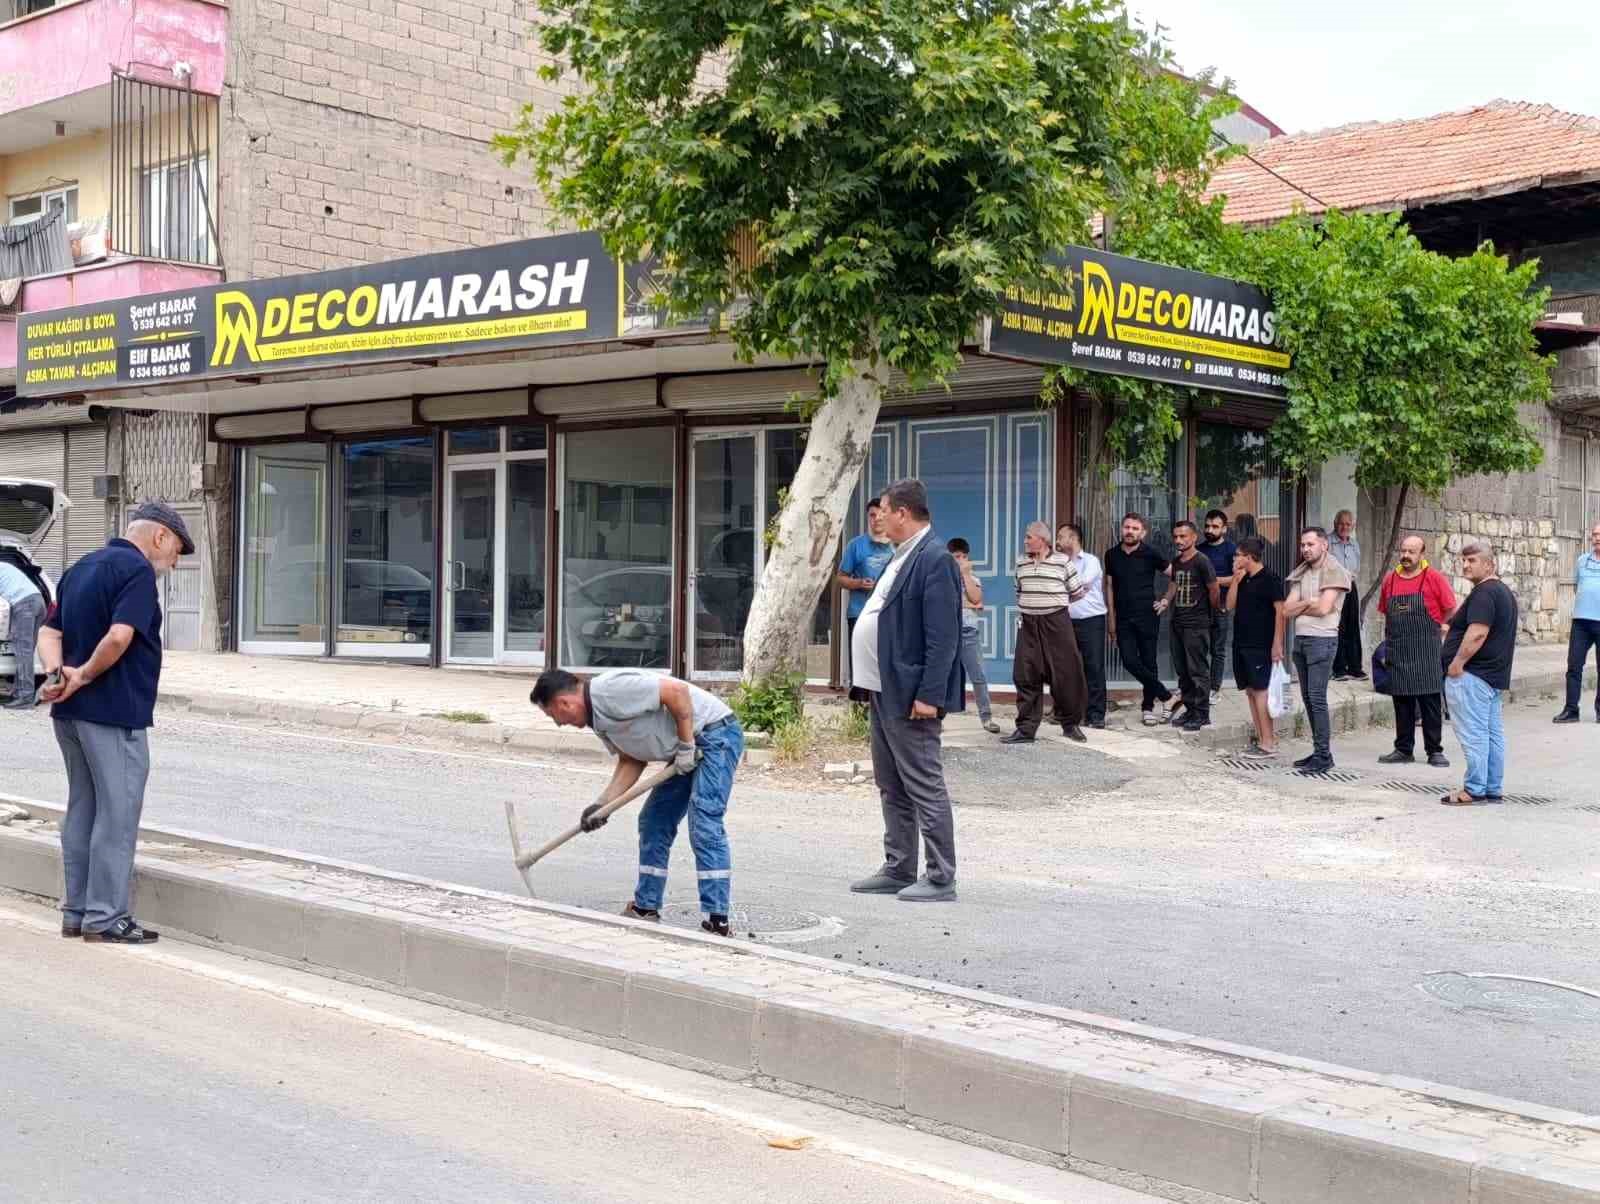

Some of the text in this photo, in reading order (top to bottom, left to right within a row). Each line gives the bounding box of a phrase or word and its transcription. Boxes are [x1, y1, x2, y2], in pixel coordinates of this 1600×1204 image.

[262, 258, 589, 337] DECOMARASH
[130, 296, 196, 322] Şeref BARAK
[172, 314, 183, 325] 41
[184, 312, 194, 324] 37
[1117, 282, 1281, 346] DECOMARAS
[27, 324, 55, 339] DUVAR
[93, 314, 115, 330] BOYA
[28, 347, 45, 361] HER
[45, 342, 72, 359] TÜRLÜ
[129, 343, 191, 365] Elif BARAK
[1072, 341, 1122, 360] Şeref BARAK
[25, 369, 47, 384] ASMA
[49, 364, 75, 381] TAVAN
[1208, 364, 1233, 377] BARAK
